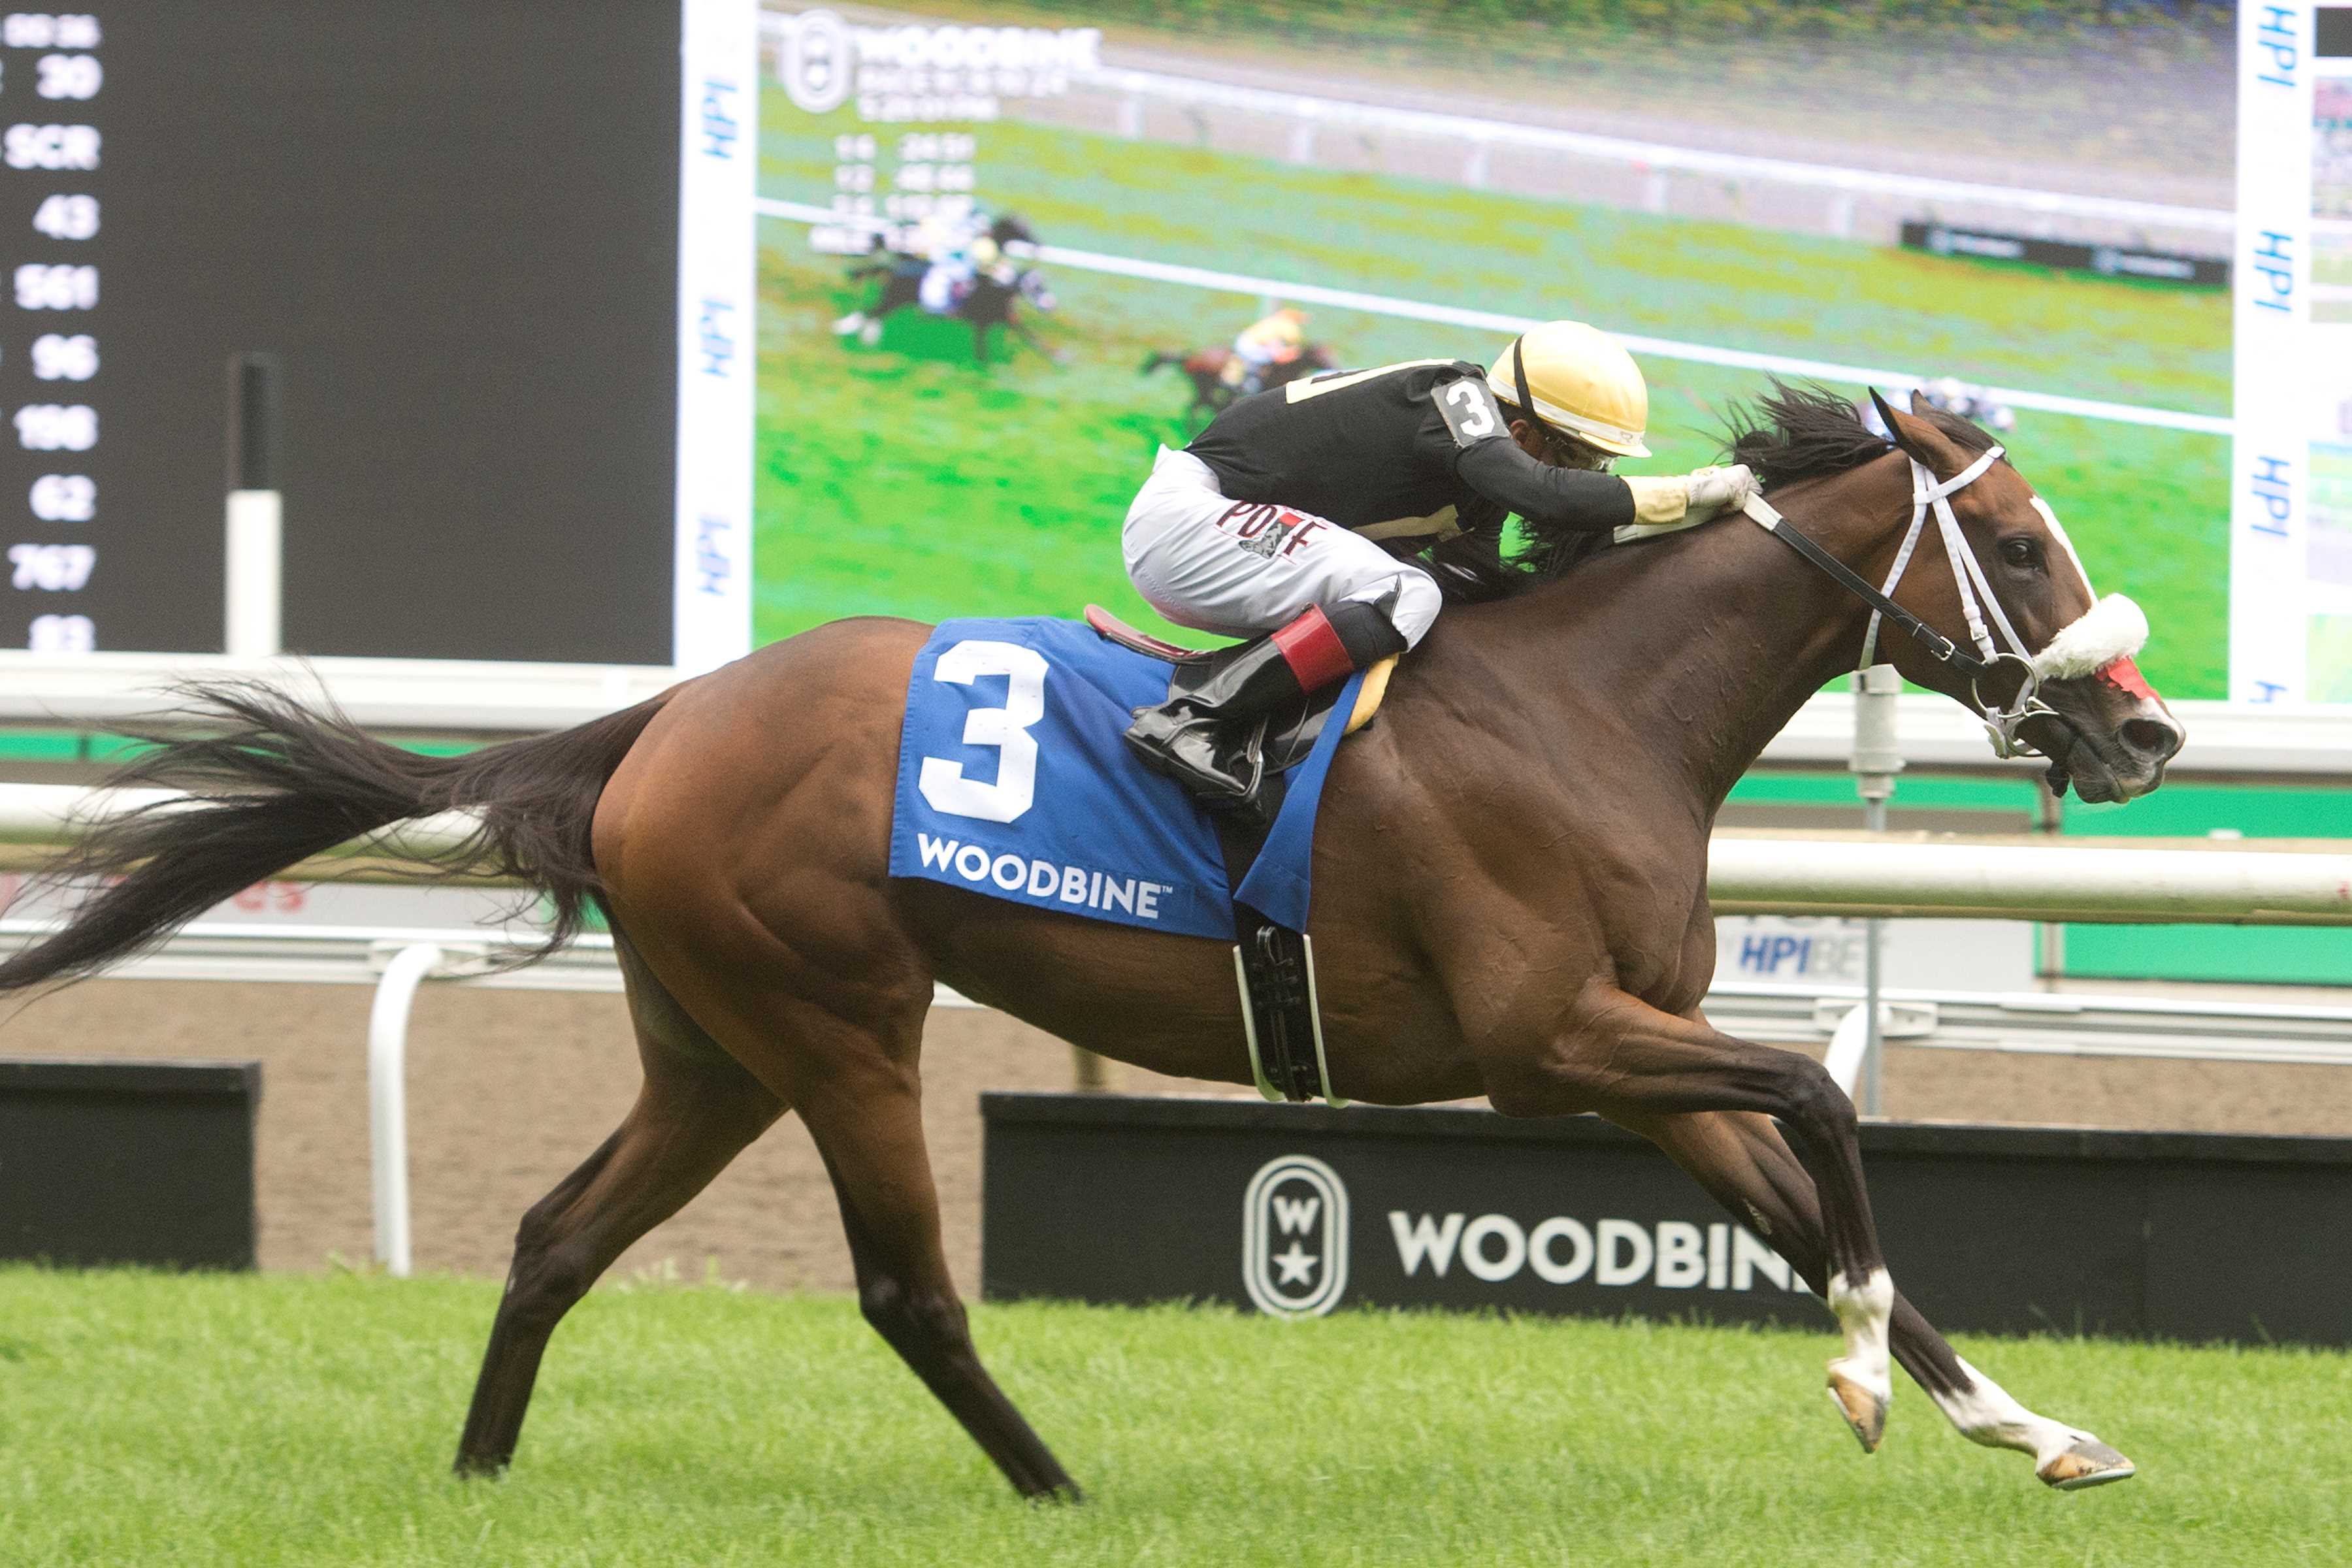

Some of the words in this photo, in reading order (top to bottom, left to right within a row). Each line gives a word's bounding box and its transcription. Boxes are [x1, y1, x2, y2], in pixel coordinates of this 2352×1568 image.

[5, 123, 101, 171] SCR
[1446, 381, 1495, 436] 3
[919, 640, 1049, 823] 3
[1389, 1211, 1814, 1292] WOODBIN
